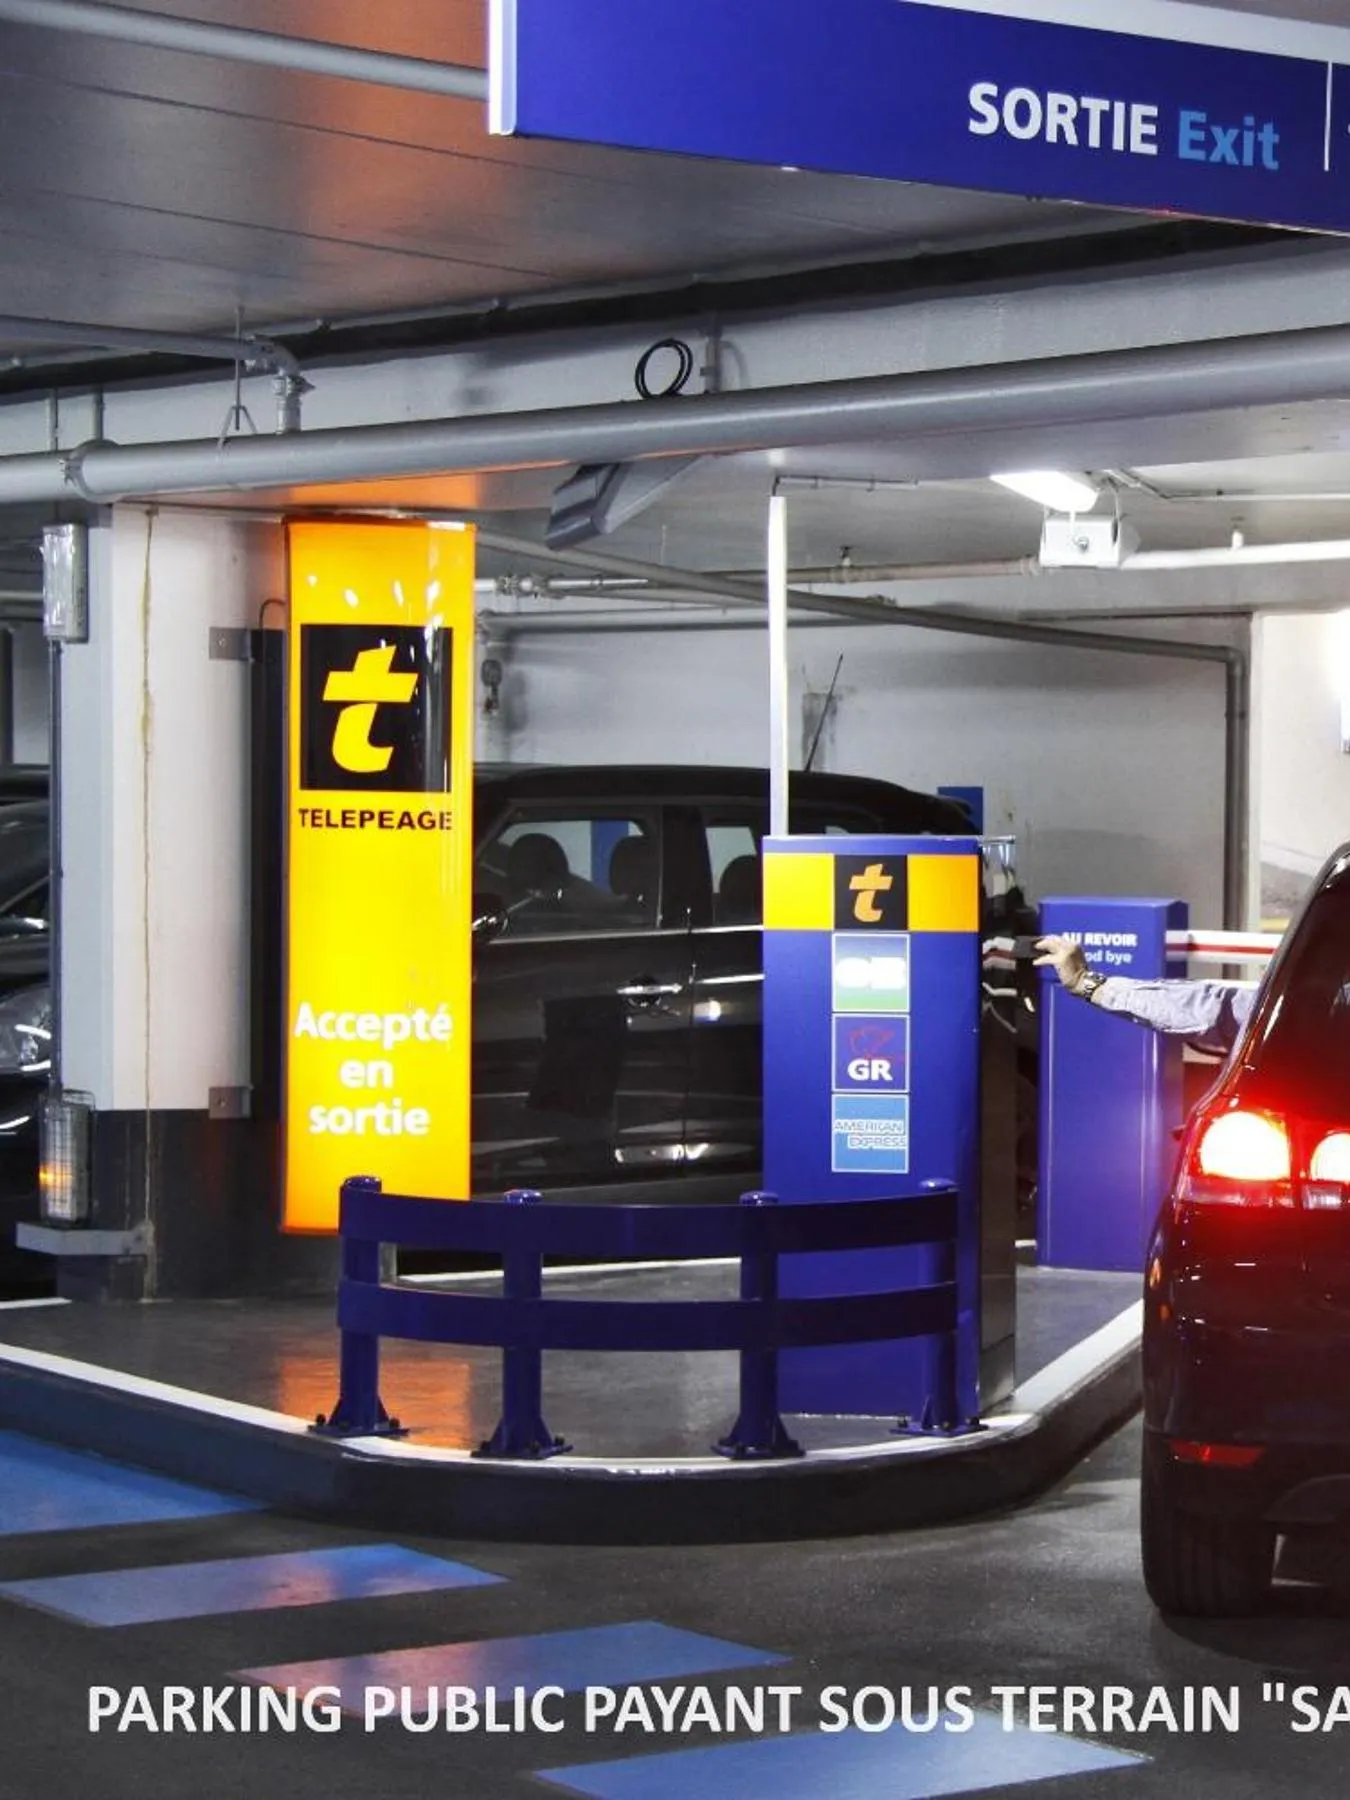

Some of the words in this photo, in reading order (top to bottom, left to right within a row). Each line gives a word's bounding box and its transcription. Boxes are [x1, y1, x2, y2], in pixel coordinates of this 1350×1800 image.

[968, 81, 1158, 155] SORTIE
[1178, 110, 1280, 171] Exit
[298, 809, 453, 831] TELEPEAGE
[1084, 932, 1138, 947] REVOIR
[1105, 951, 1132, 965] bye
[295, 1001, 453, 1050] Accepté
[340, 1058, 393, 1088] en
[847, 1059, 893, 1081] GR
[309, 1098, 430, 1135] sortie
